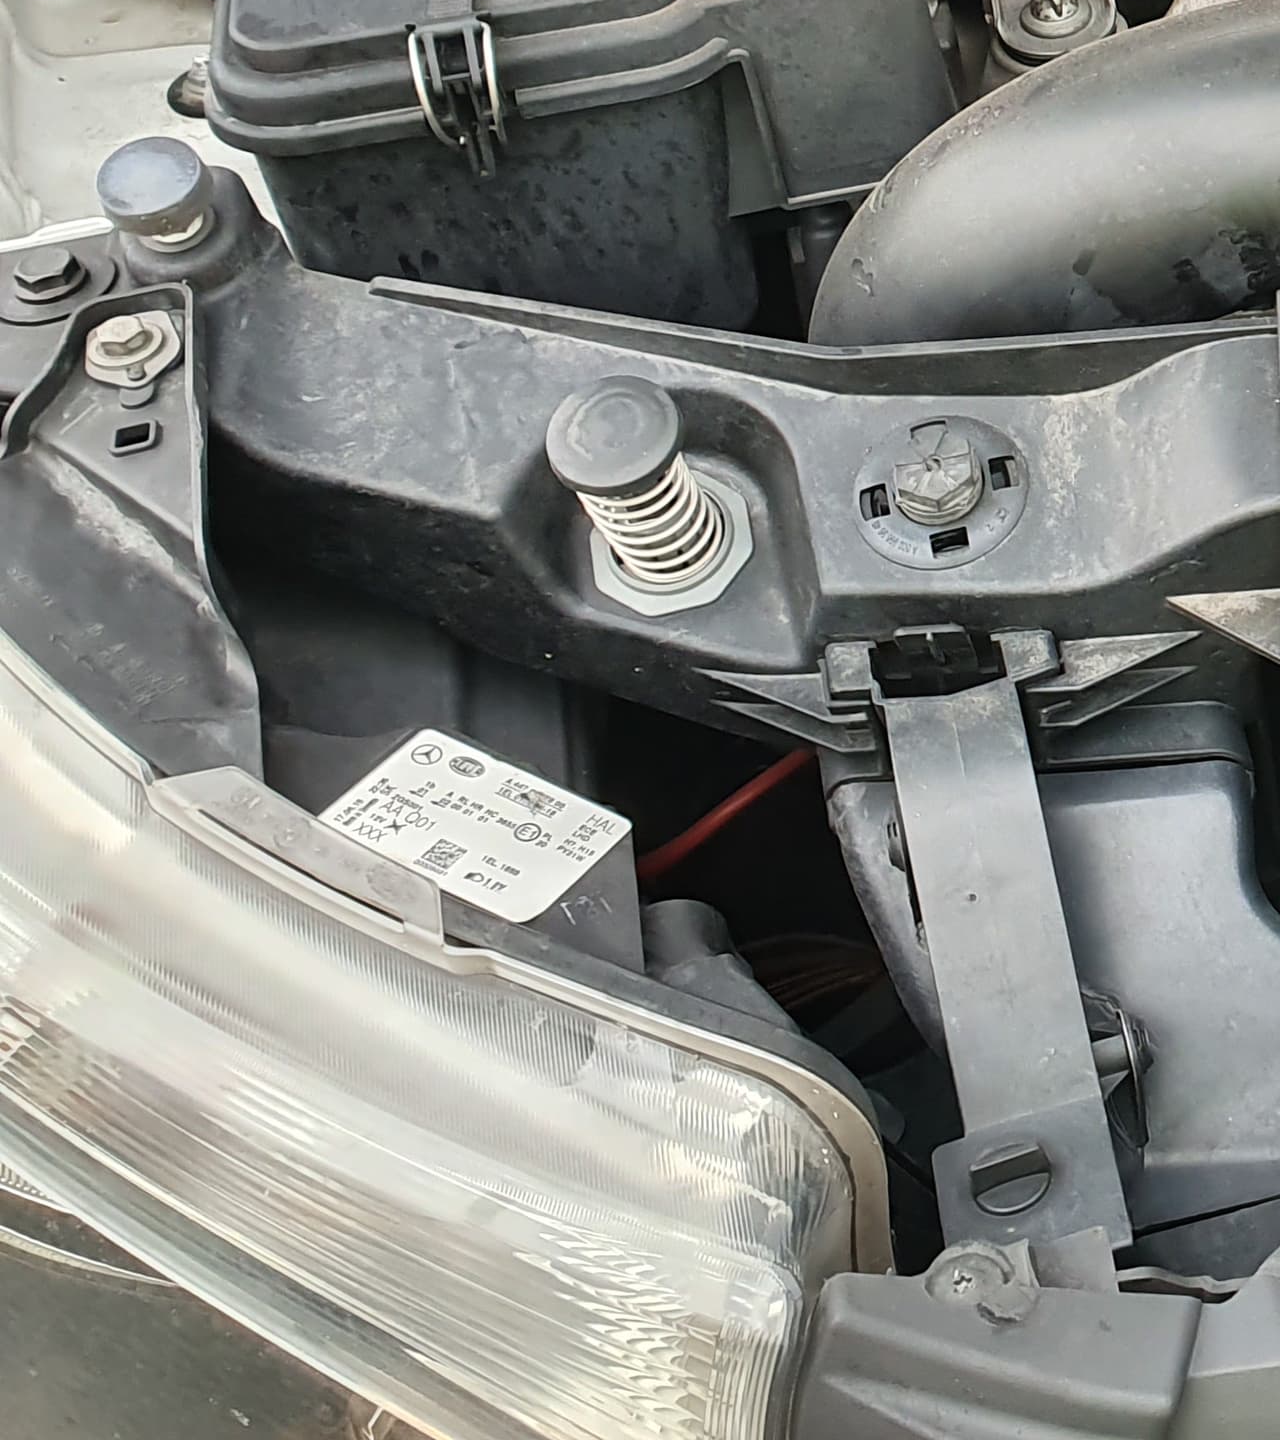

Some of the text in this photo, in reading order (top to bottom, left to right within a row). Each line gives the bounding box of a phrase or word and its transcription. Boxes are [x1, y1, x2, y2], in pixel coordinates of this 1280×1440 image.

[379, 800, 405, 817] AA
[352, 821, 388, 843] XXX
[586, 814, 617, 836] HAL
